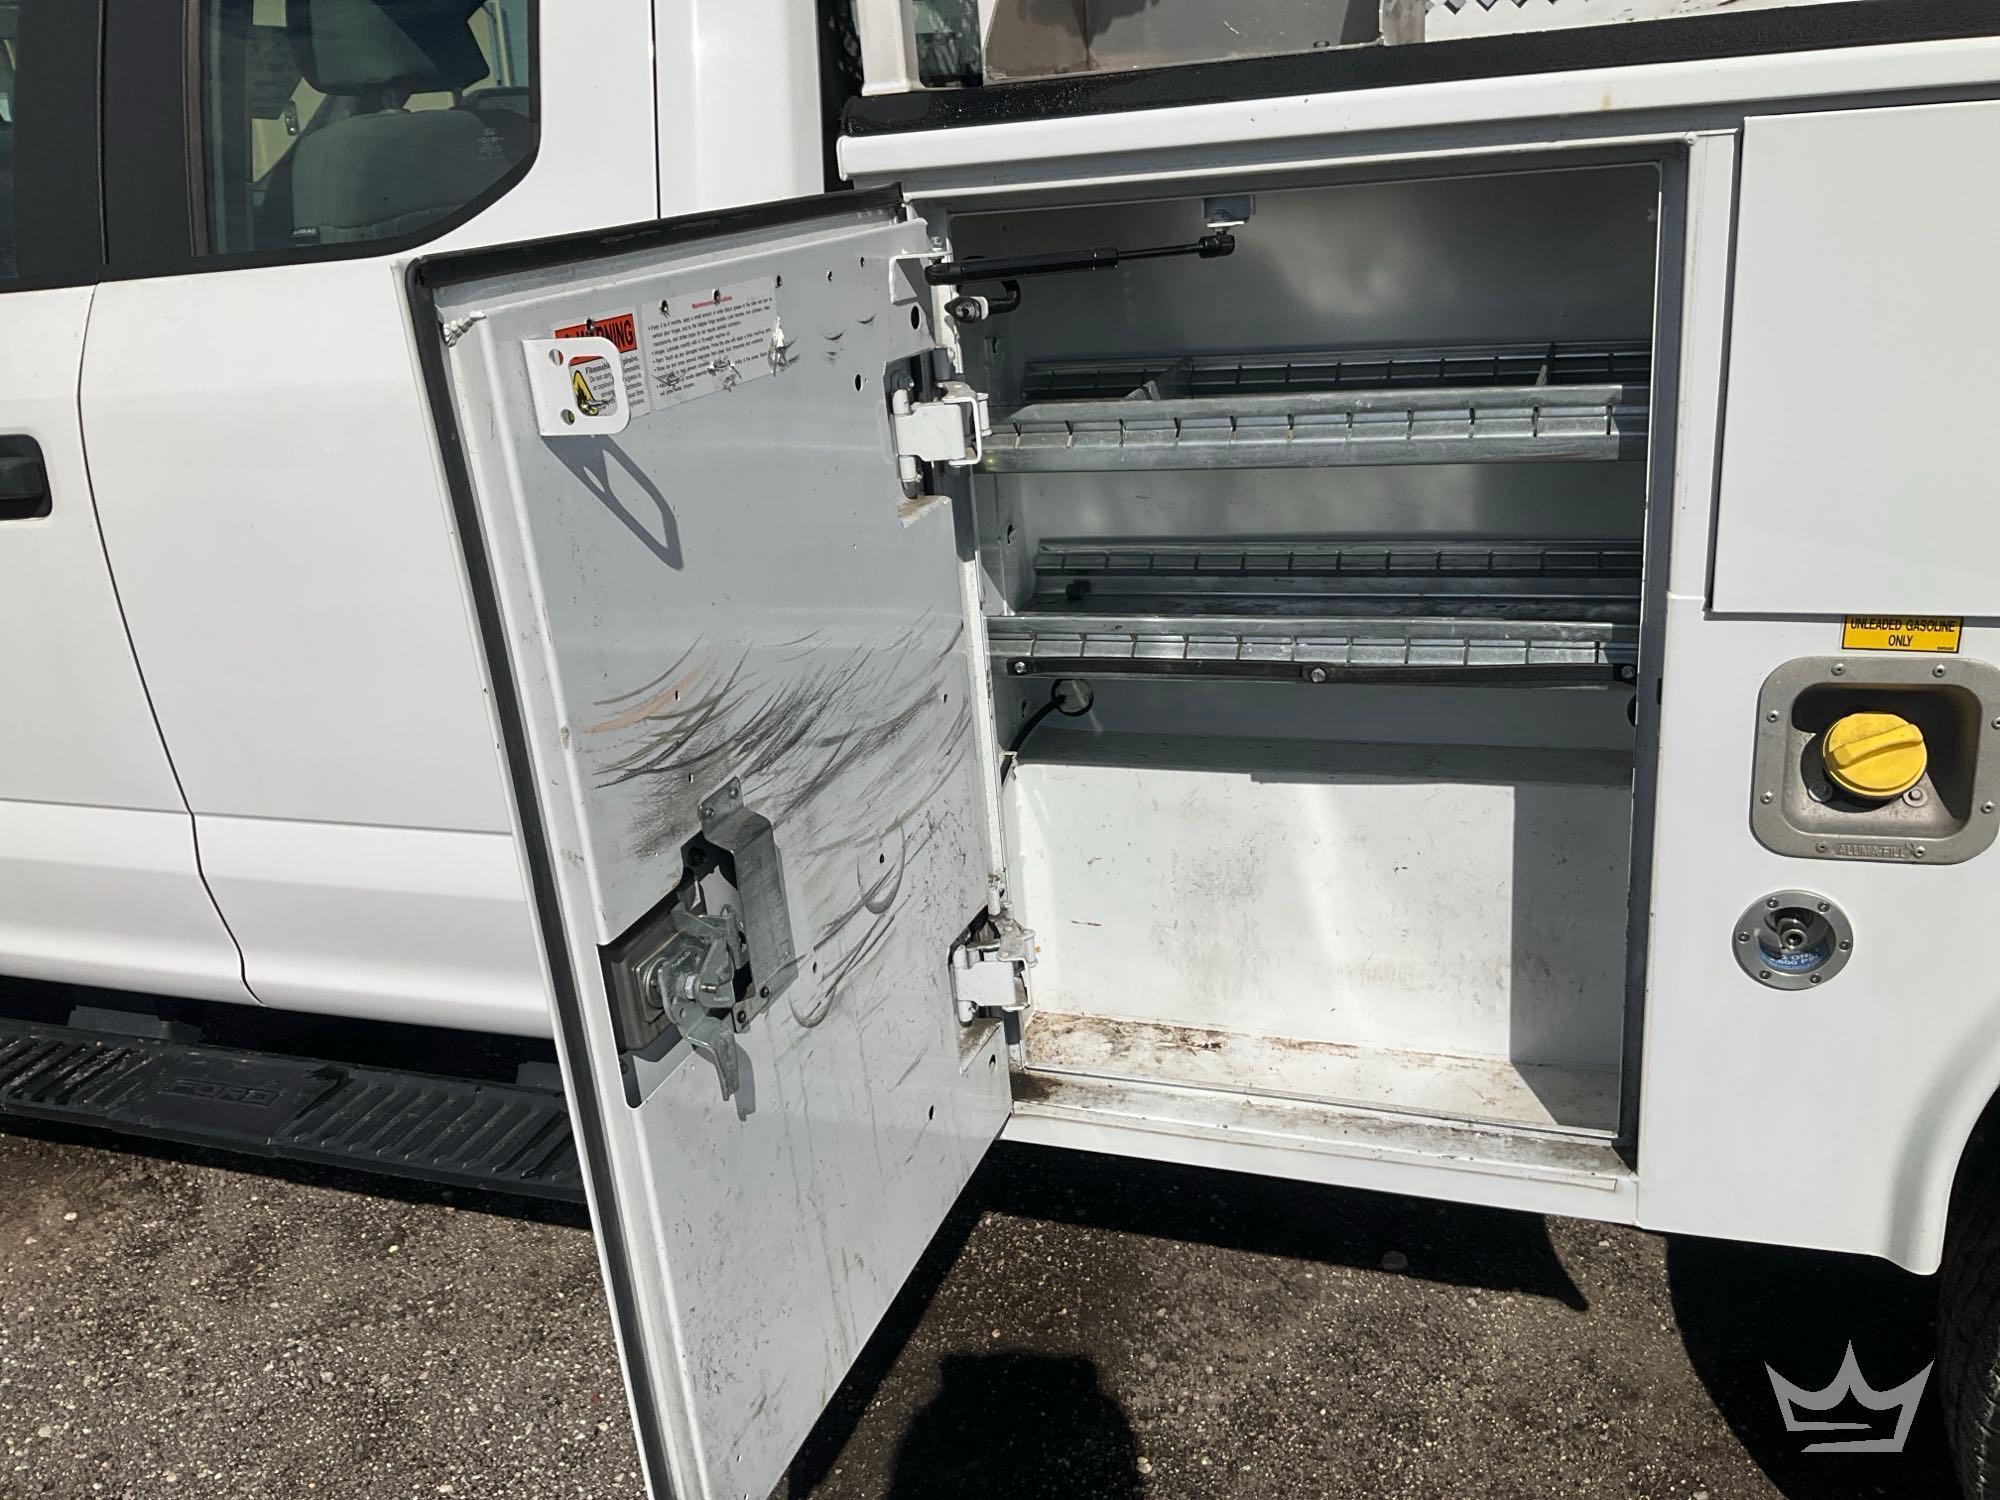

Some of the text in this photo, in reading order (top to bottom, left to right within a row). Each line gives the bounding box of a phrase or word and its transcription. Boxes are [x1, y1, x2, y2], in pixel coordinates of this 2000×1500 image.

[1850, 617, 1955, 632] UNLEADED GASOLINE
[1888, 634, 1913, 647] ONLY
[1839, 843, 1906, 858] ALUMA-FILL
